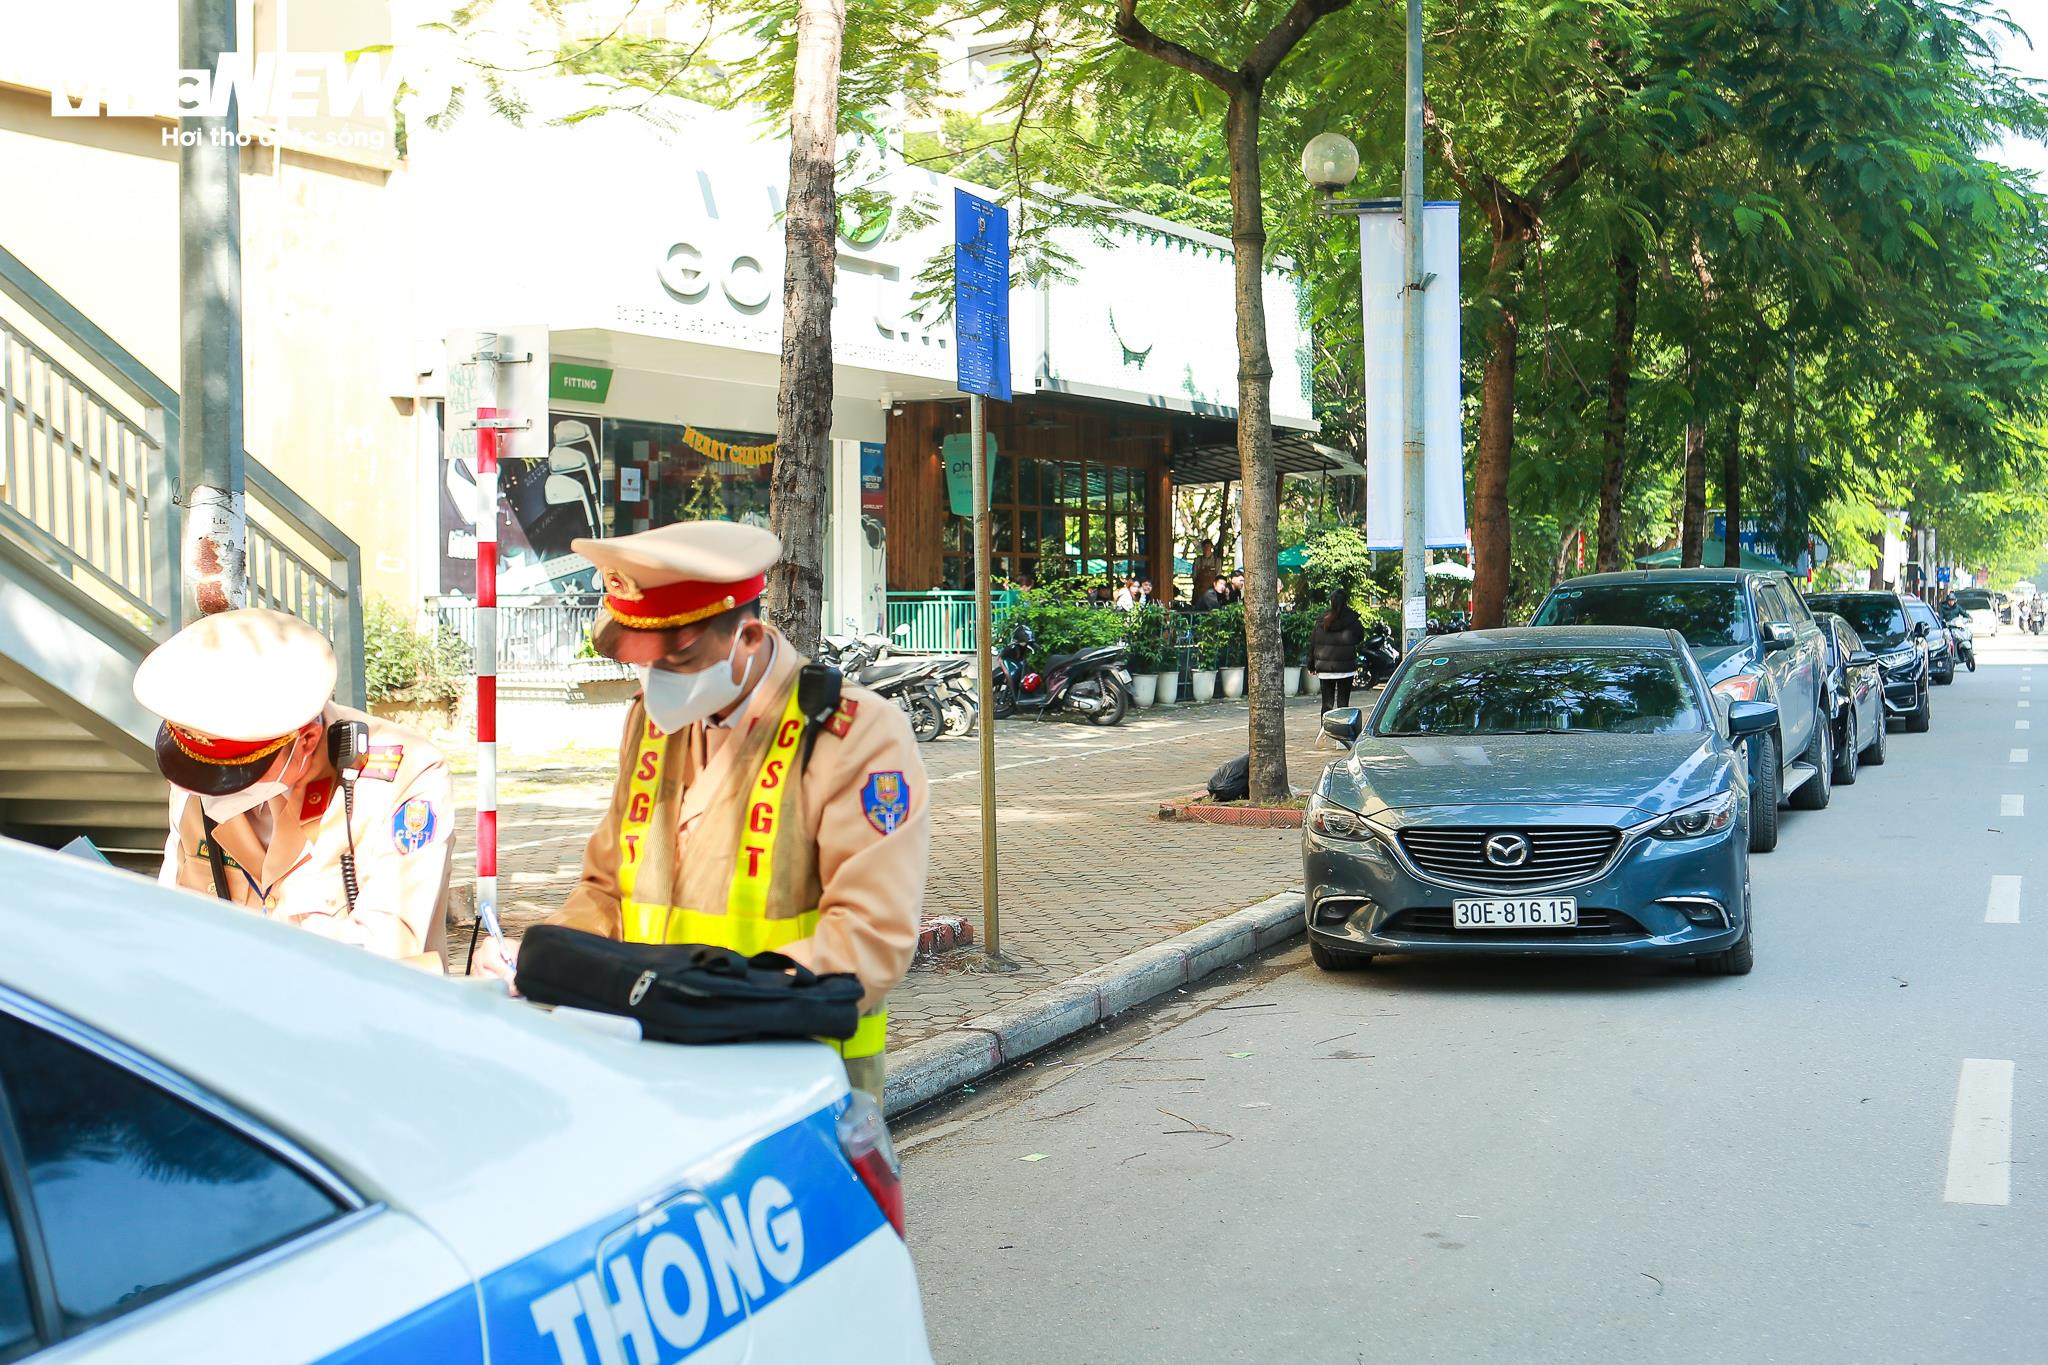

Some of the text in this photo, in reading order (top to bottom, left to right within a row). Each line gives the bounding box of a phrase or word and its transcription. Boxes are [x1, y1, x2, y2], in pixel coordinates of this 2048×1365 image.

[563, 376, 597, 390] FITTING
[682, 425, 776, 465] MERRY CHRIST
[953, 460, 972, 474] ph
[746, 719, 799, 878] CSGT
[1457, 901, 1572, 924] 30E-816.15
[529, 1175, 805, 1365] THÔNG
